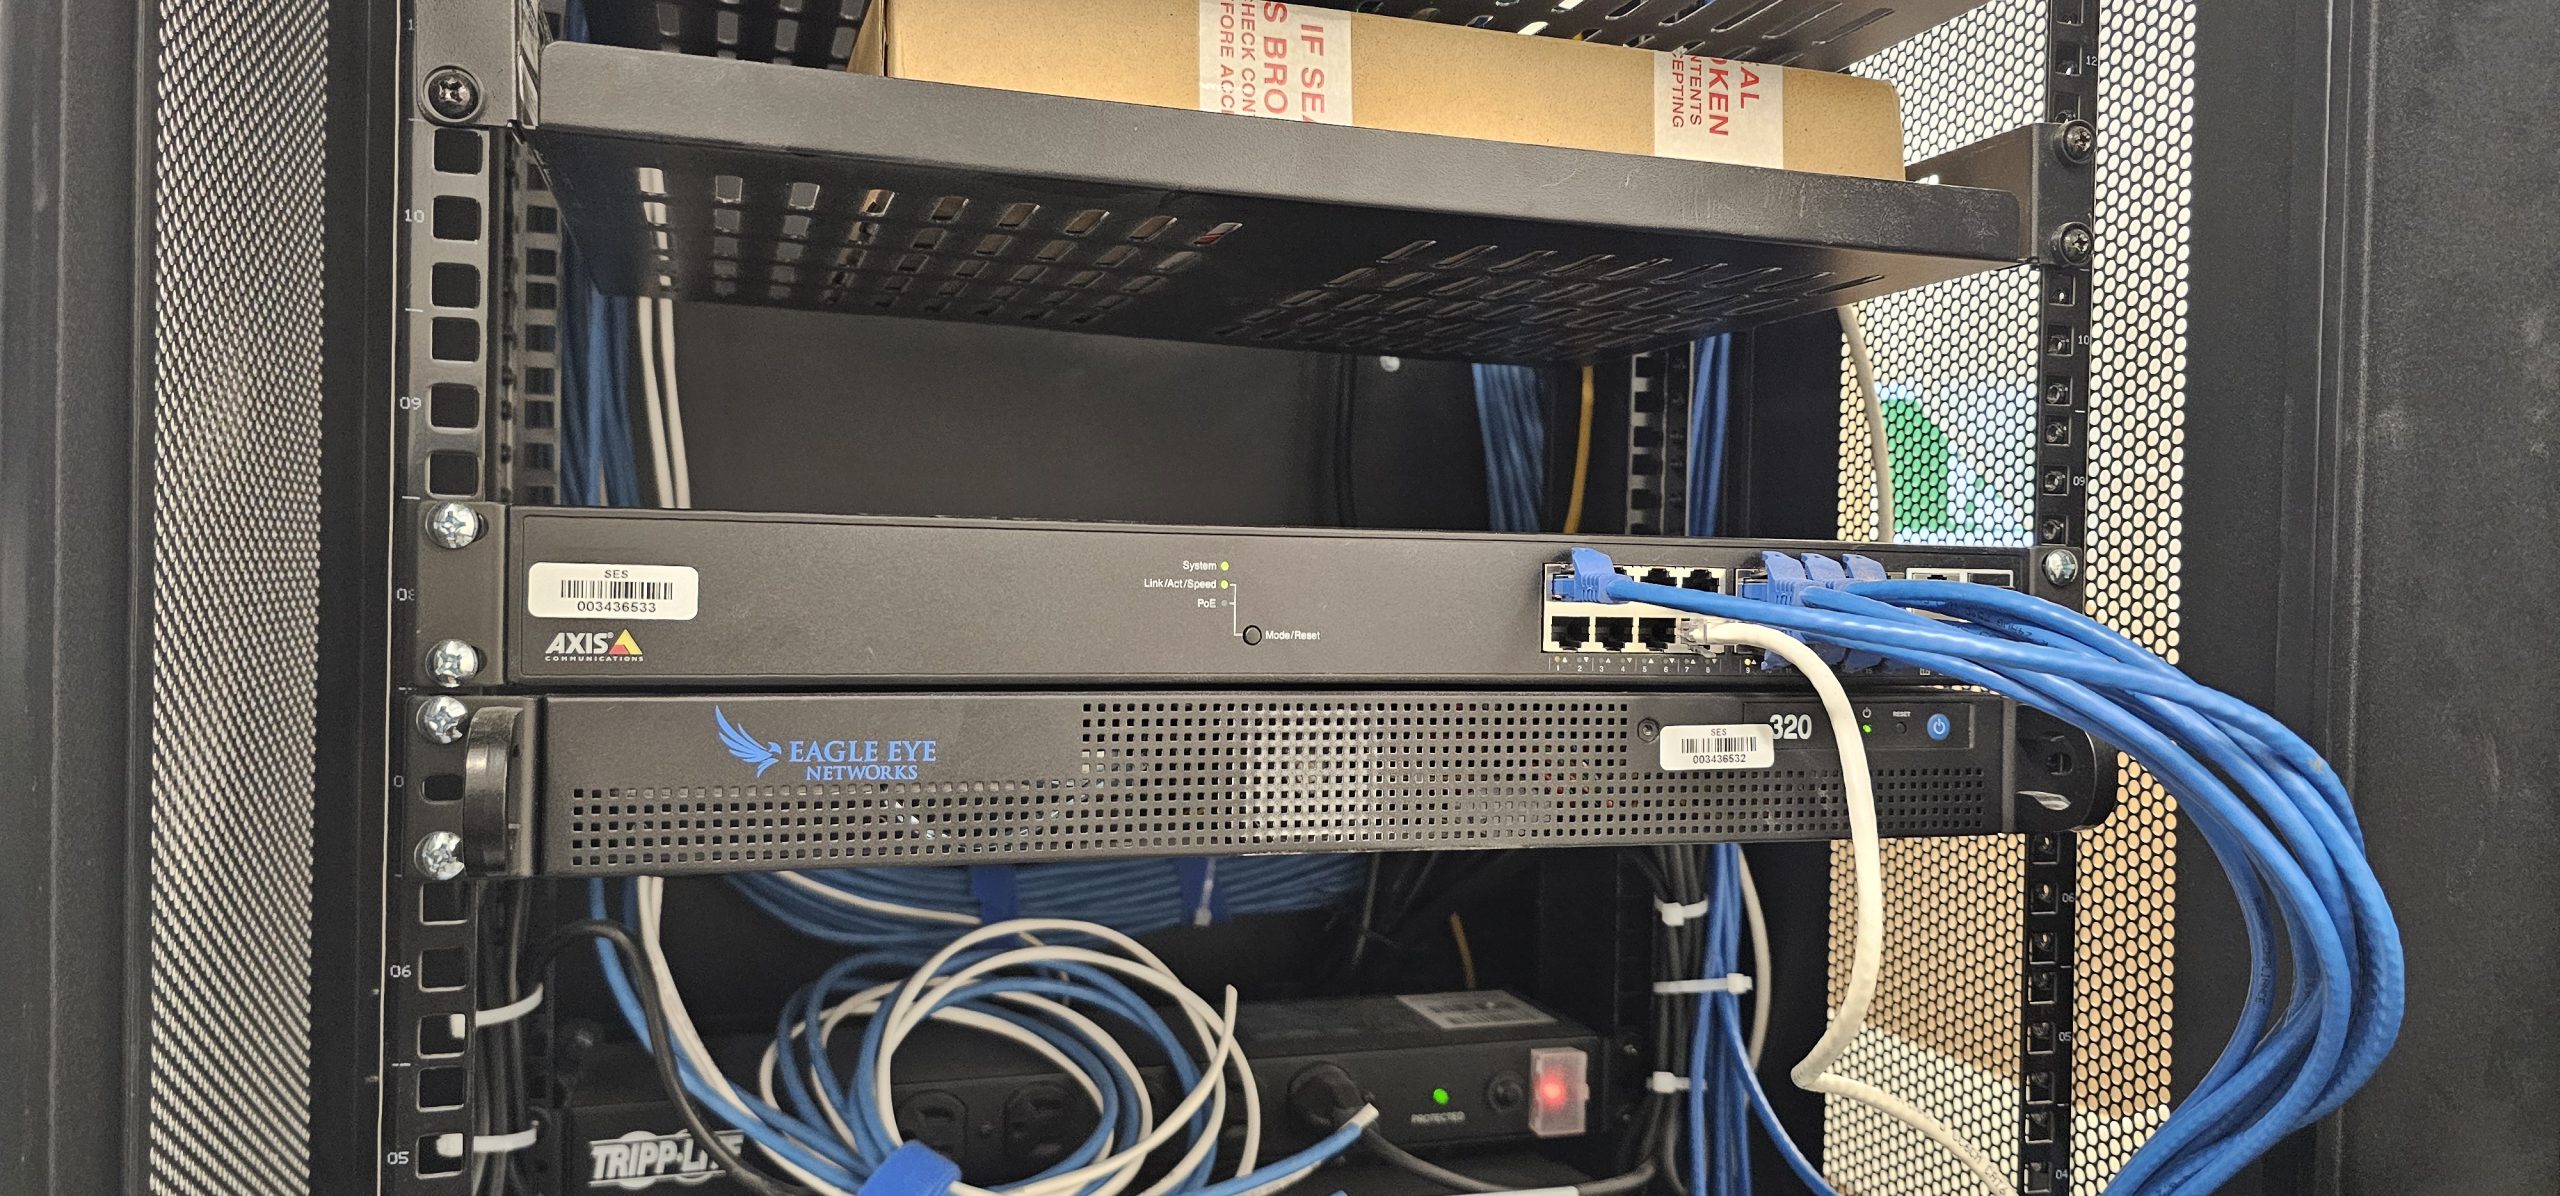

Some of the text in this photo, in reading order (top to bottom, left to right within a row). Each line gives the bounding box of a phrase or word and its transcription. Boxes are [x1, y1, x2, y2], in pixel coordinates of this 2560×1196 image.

[1220, 0, 1234, 58] FORE
[1301, 24, 1324, 56] IF
[1241, 0, 1256, 117] HECK CON
[2086, 55, 2098, 66] 12
[1263, 36, 1289, 114] BRO
[1672, 54, 1684, 128] EPTING
[1740, 61, 1760, 109] AL
[404, 208, 425, 224] 10
[2078, 334, 2090, 345] 10
[399, 396, 422, 410] 09
[2072, 475, 2086, 486] 09
[1182, 560, 1217, 572] System
[604, 569, 629, 579] SES
[1144, 578, 1217, 590] Link/Act/Speed
[577, 600, 657, 613] 003436533
[1197, 599, 1217, 608] PoE
[1265, 630, 1321, 641] Mode/Reset
[1710, 728, 1727, 737] SES
[1769, 714, 1813, 740] 320
[789, 740, 937, 763] EAGLE EYE
[1692, 754, 1747, 764] 003436532
[806, 764, 918, 781] NETWORKS
[389, 964, 412, 978] 06
[2058, 1031, 2072, 1042] 05
[387, 1151, 410, 1165] 05
